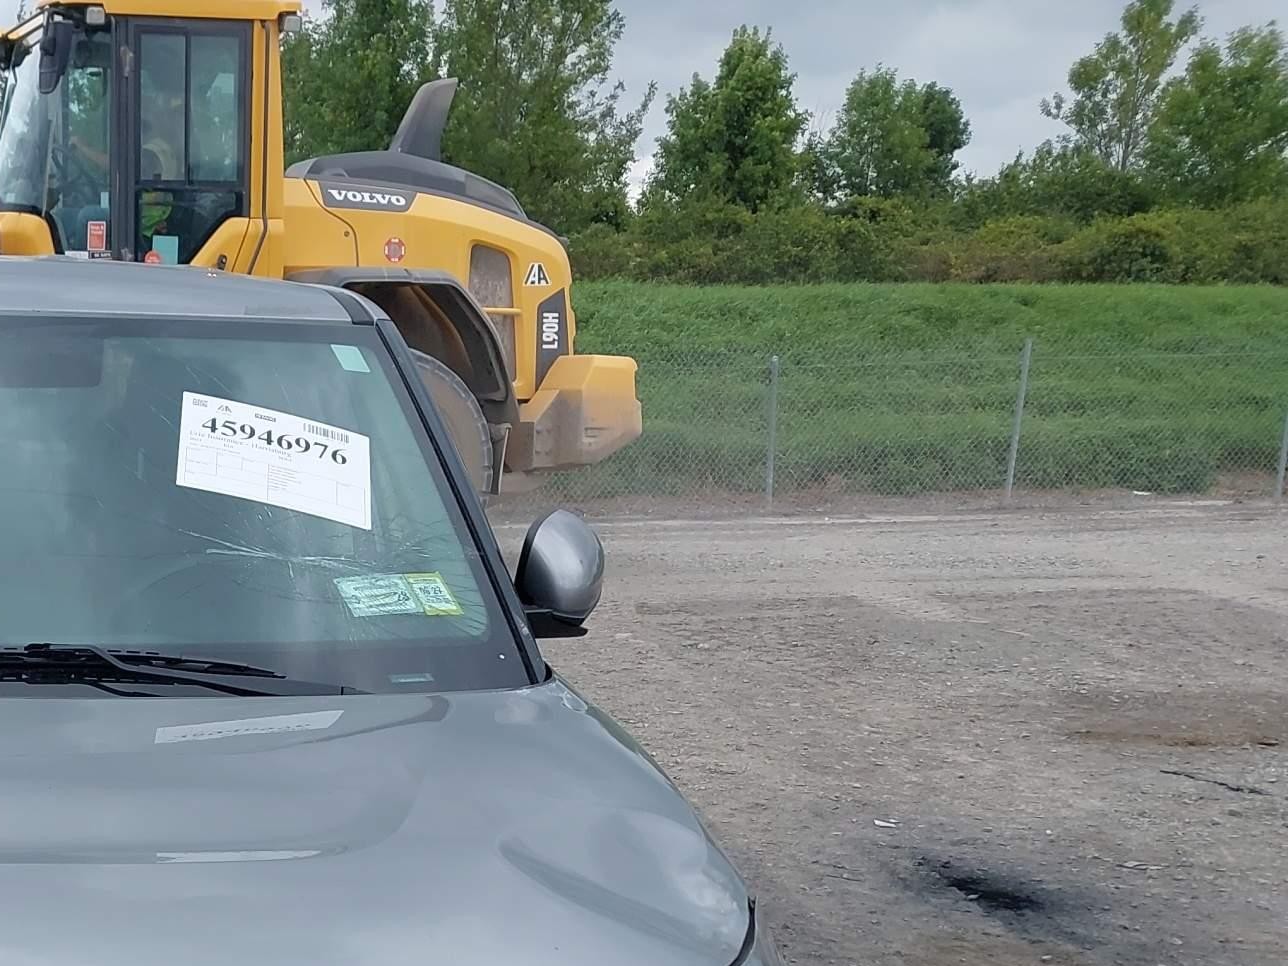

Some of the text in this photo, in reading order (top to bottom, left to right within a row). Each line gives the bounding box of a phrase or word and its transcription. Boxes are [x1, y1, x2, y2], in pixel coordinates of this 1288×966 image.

[327, 189, 407, 207] VOLVO
[541, 312, 560, 350] L90H
[201, 417, 348, 465] 45946976
